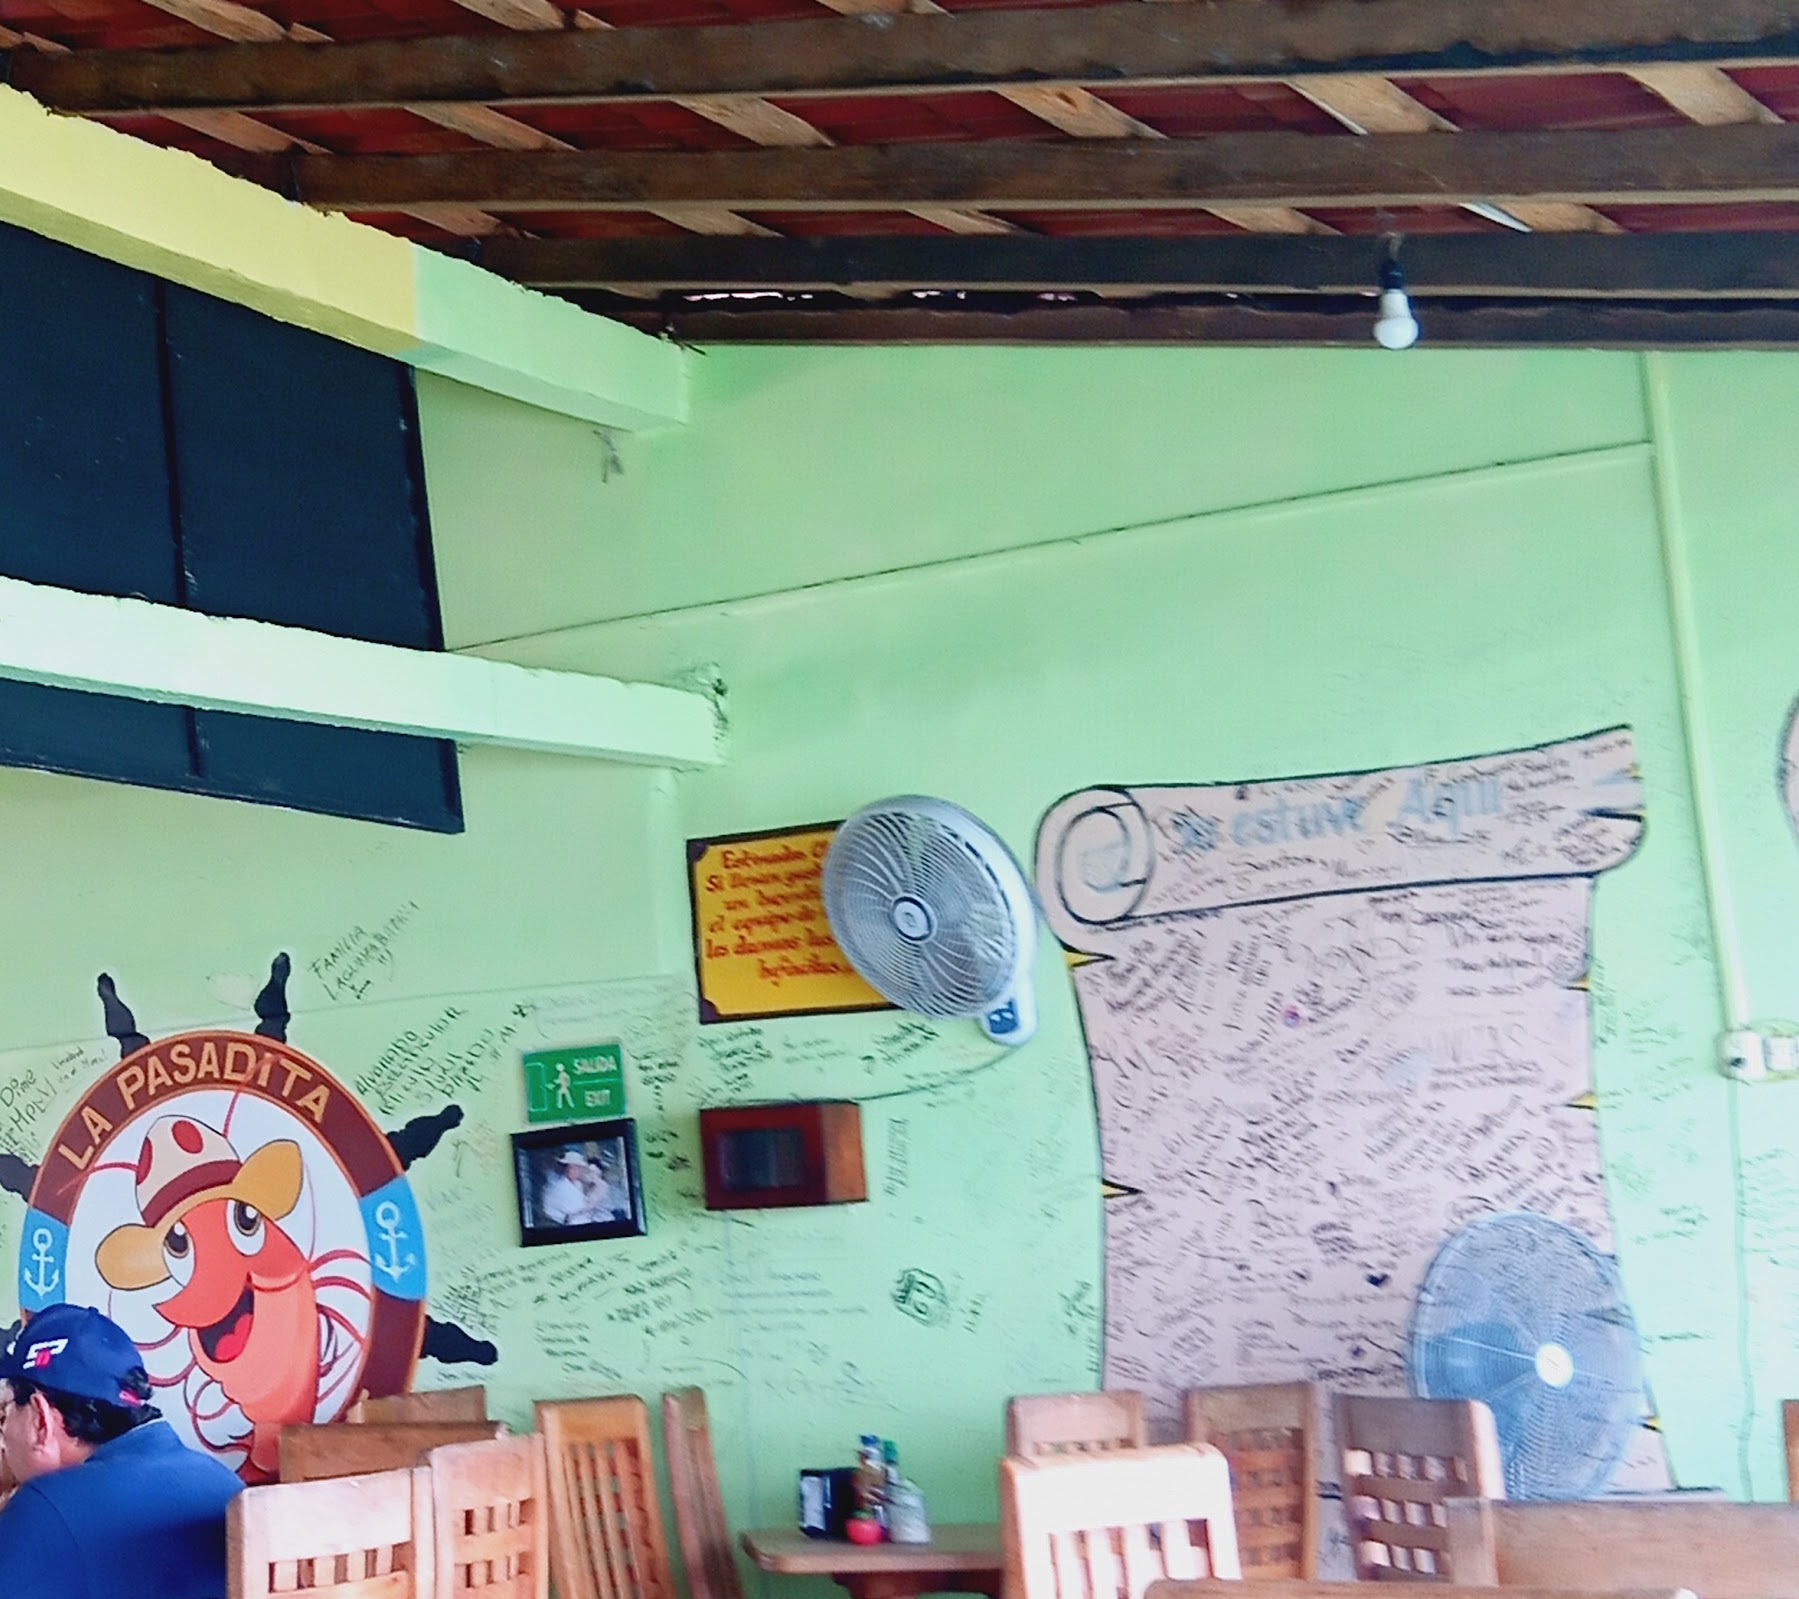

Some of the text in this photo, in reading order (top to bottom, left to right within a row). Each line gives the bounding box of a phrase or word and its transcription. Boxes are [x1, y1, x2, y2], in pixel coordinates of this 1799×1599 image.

[573, 1055, 618, 1075] SALIDA
[58, 1105, 114, 1171] LA
[115, 1041, 331, 1125] PASADITA
[584, 1088, 611, 1108] EXIT
